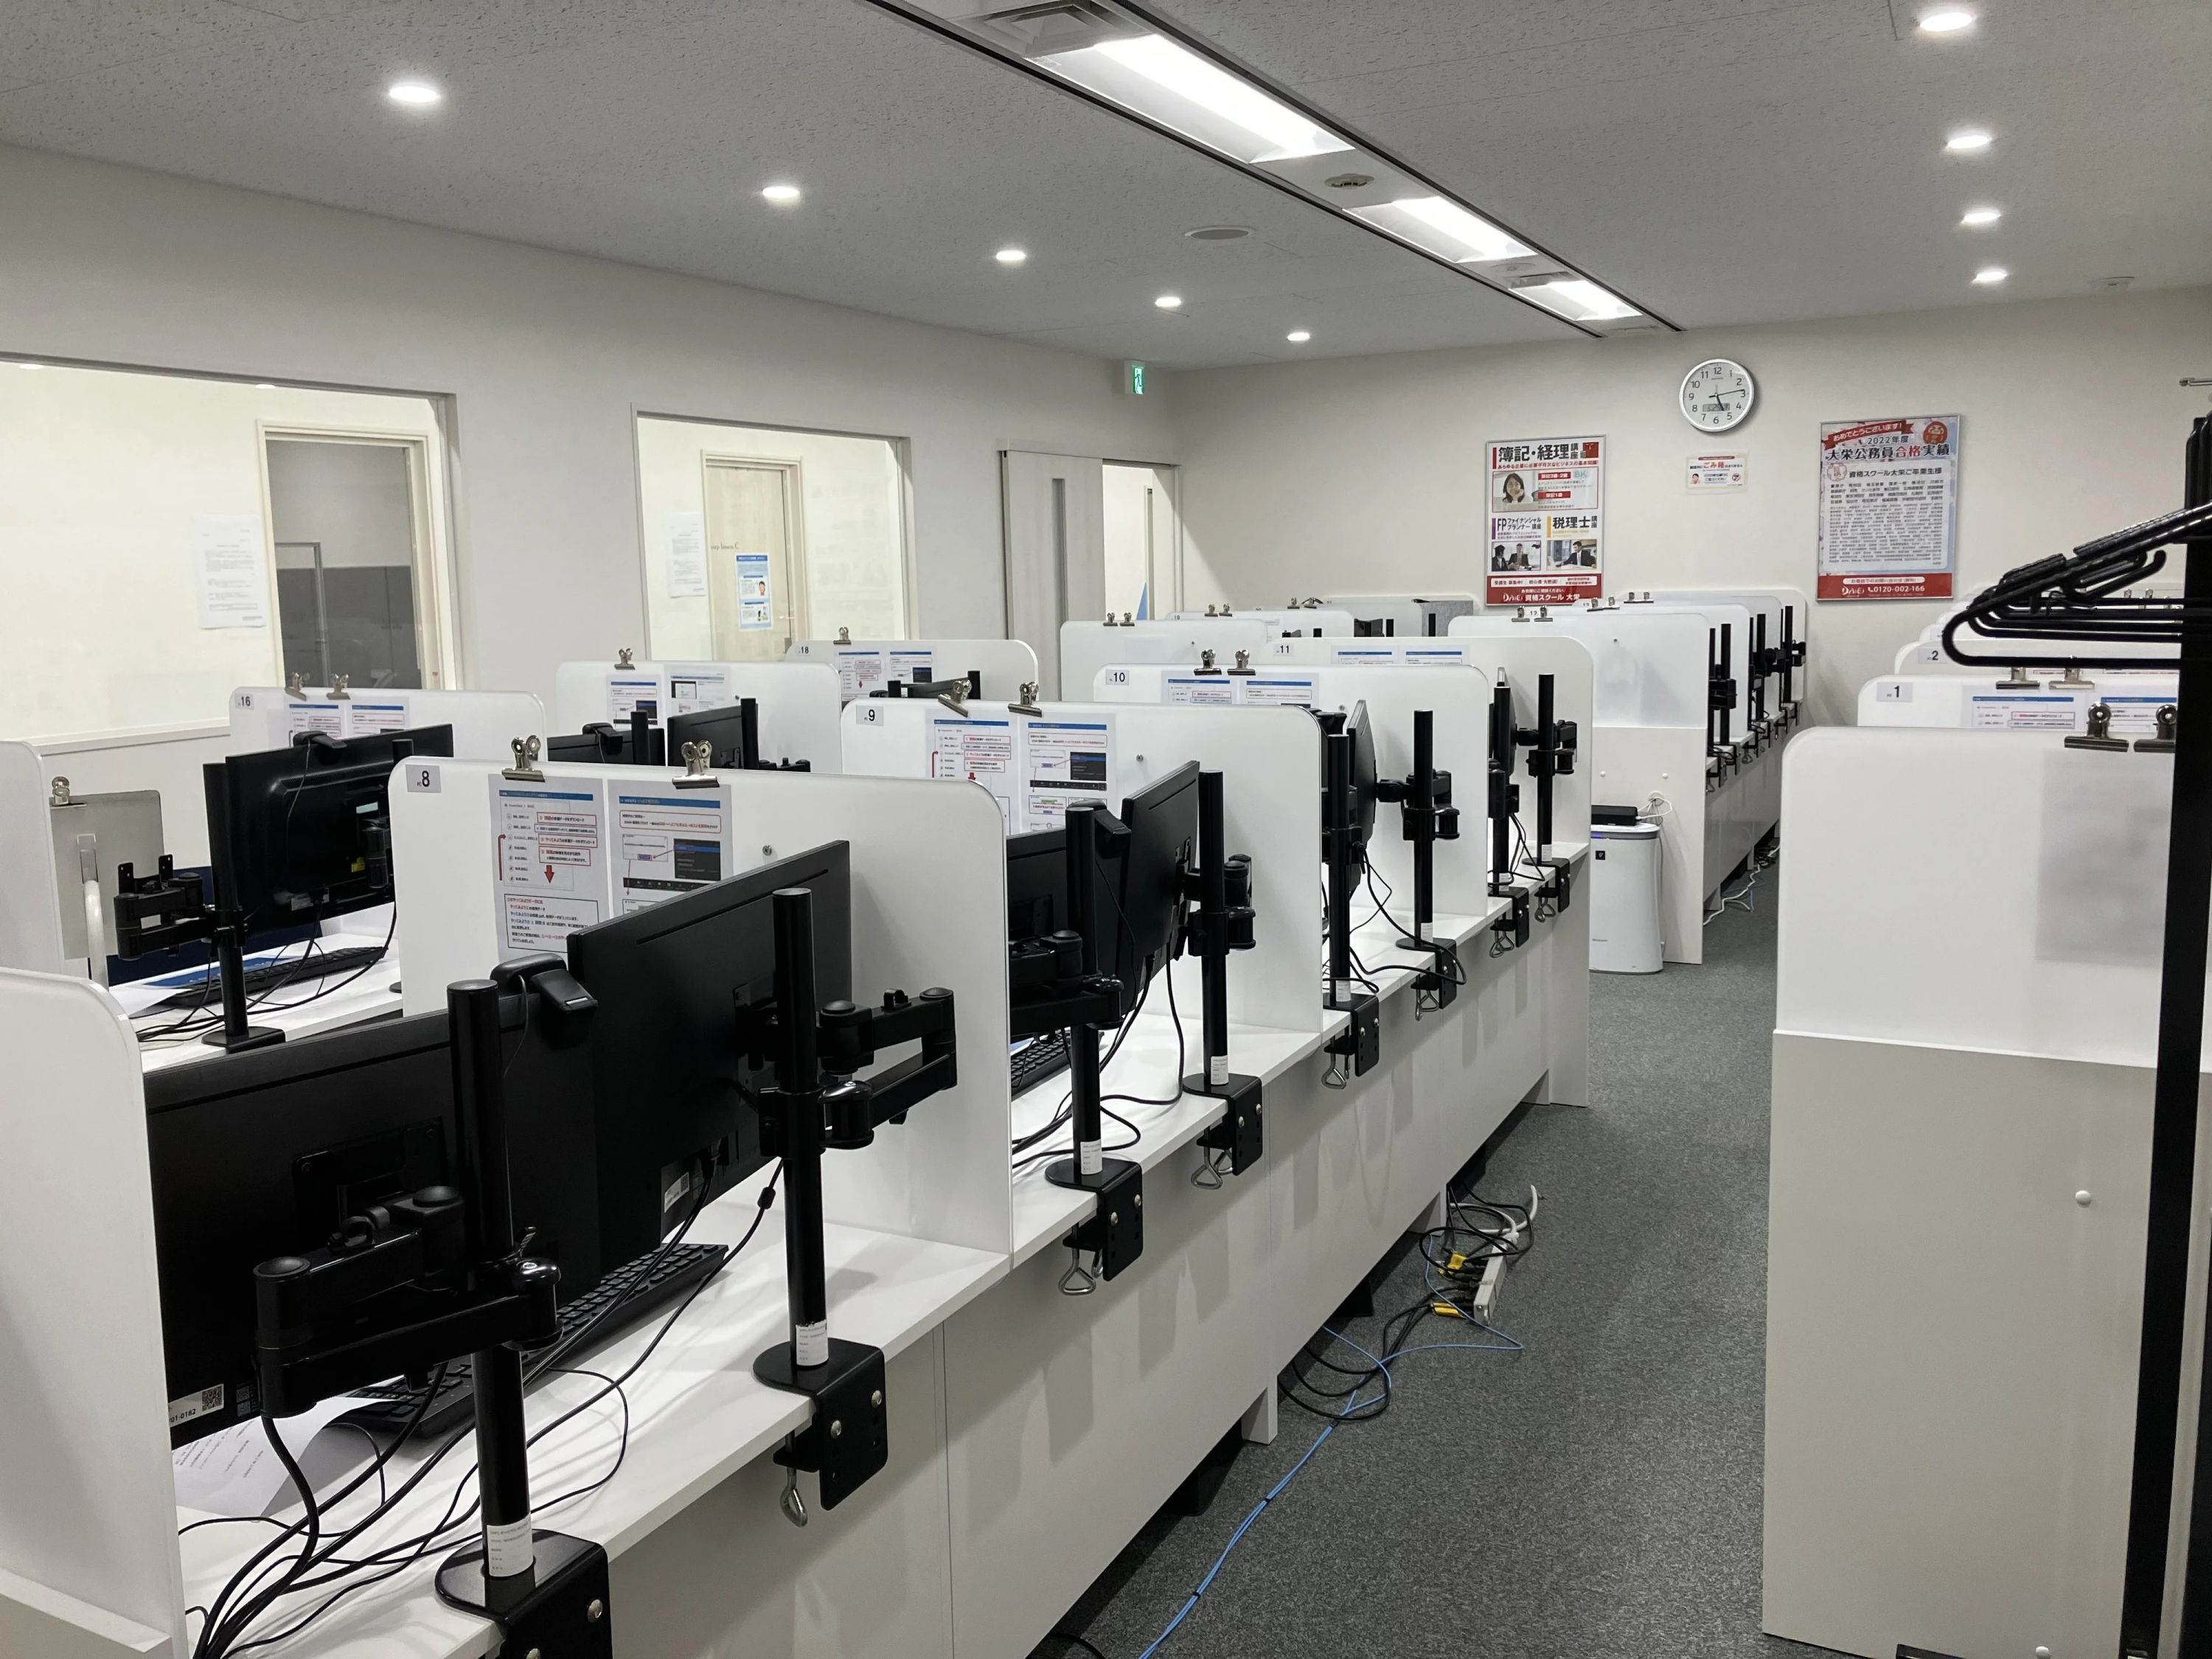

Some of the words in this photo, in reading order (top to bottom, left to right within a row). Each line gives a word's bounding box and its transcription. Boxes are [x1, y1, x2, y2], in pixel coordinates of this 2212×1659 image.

[1700, 371, 1708, 379] 11
[1713, 366, 1722, 375] 12
[1729, 369, 1733, 378] 1
[1691, 380, 1700, 389] 10
[1688, 392, 1694, 400] 9
[1740, 390, 1746, 398] 3
[1702, 413, 1707, 422] 7
[1713, 416, 1719, 425] 6
[1726, 412, 1733, 420] 5
[1867, 436, 1910, 445] 2022年度
[1498, 444, 1570, 462] 簿記・経理
[1570, 443, 1579, 459] 講座
[1827, 443, 1950, 461] 大栄公務員合格実績
[1497, 518, 1507, 532] FP
[1507, 517, 1542, 525] ファイナンシャル
[1552, 515, 1591, 529] 税理士
[1525, 593, 1565, 602] 資格スクール
[801, 646, 809, 655] 18
[1280, 644, 1290, 654] 11
[1931, 650, 1939, 661] 2
[1113, 672, 1125, 683] 10
[1893, 686, 1900, 698] 1
[241, 696, 251, 706] 16
[868, 709, 876, 722] 9
[422, 770, 431, 787] 8
[169, 1408, 197, 1423] 01-0182
